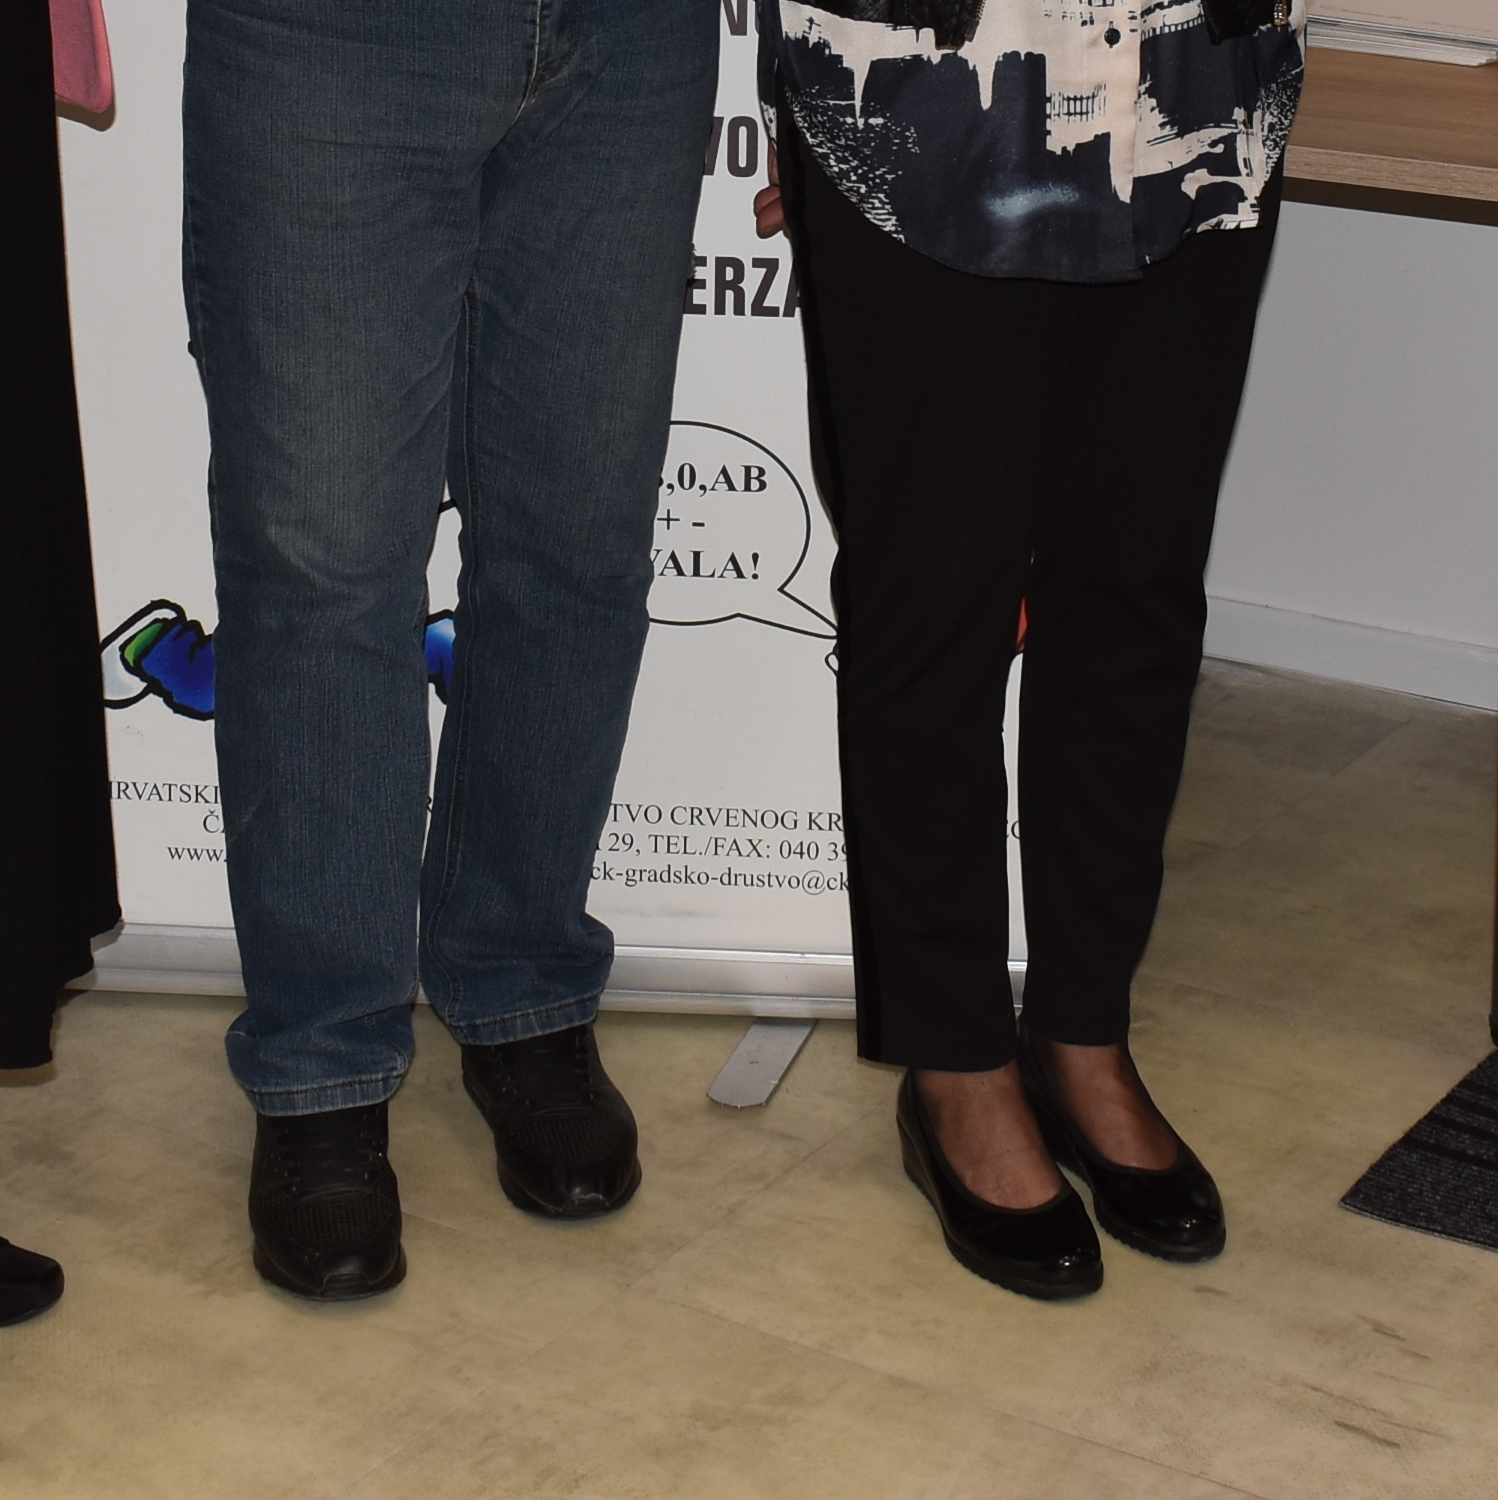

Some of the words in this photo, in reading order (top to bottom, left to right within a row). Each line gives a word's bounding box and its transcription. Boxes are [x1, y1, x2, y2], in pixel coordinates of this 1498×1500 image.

[659, 462, 768, 498] ,0,AB
[202, 809, 226, 835] Č
[610, 803, 663, 825] TVO
[670, 805, 800, 831] CRVENOG
[607, 832, 641, 857] 29,
[648, 834, 771, 860] TEL./FAX:
[779, 840, 820, 861] 040
